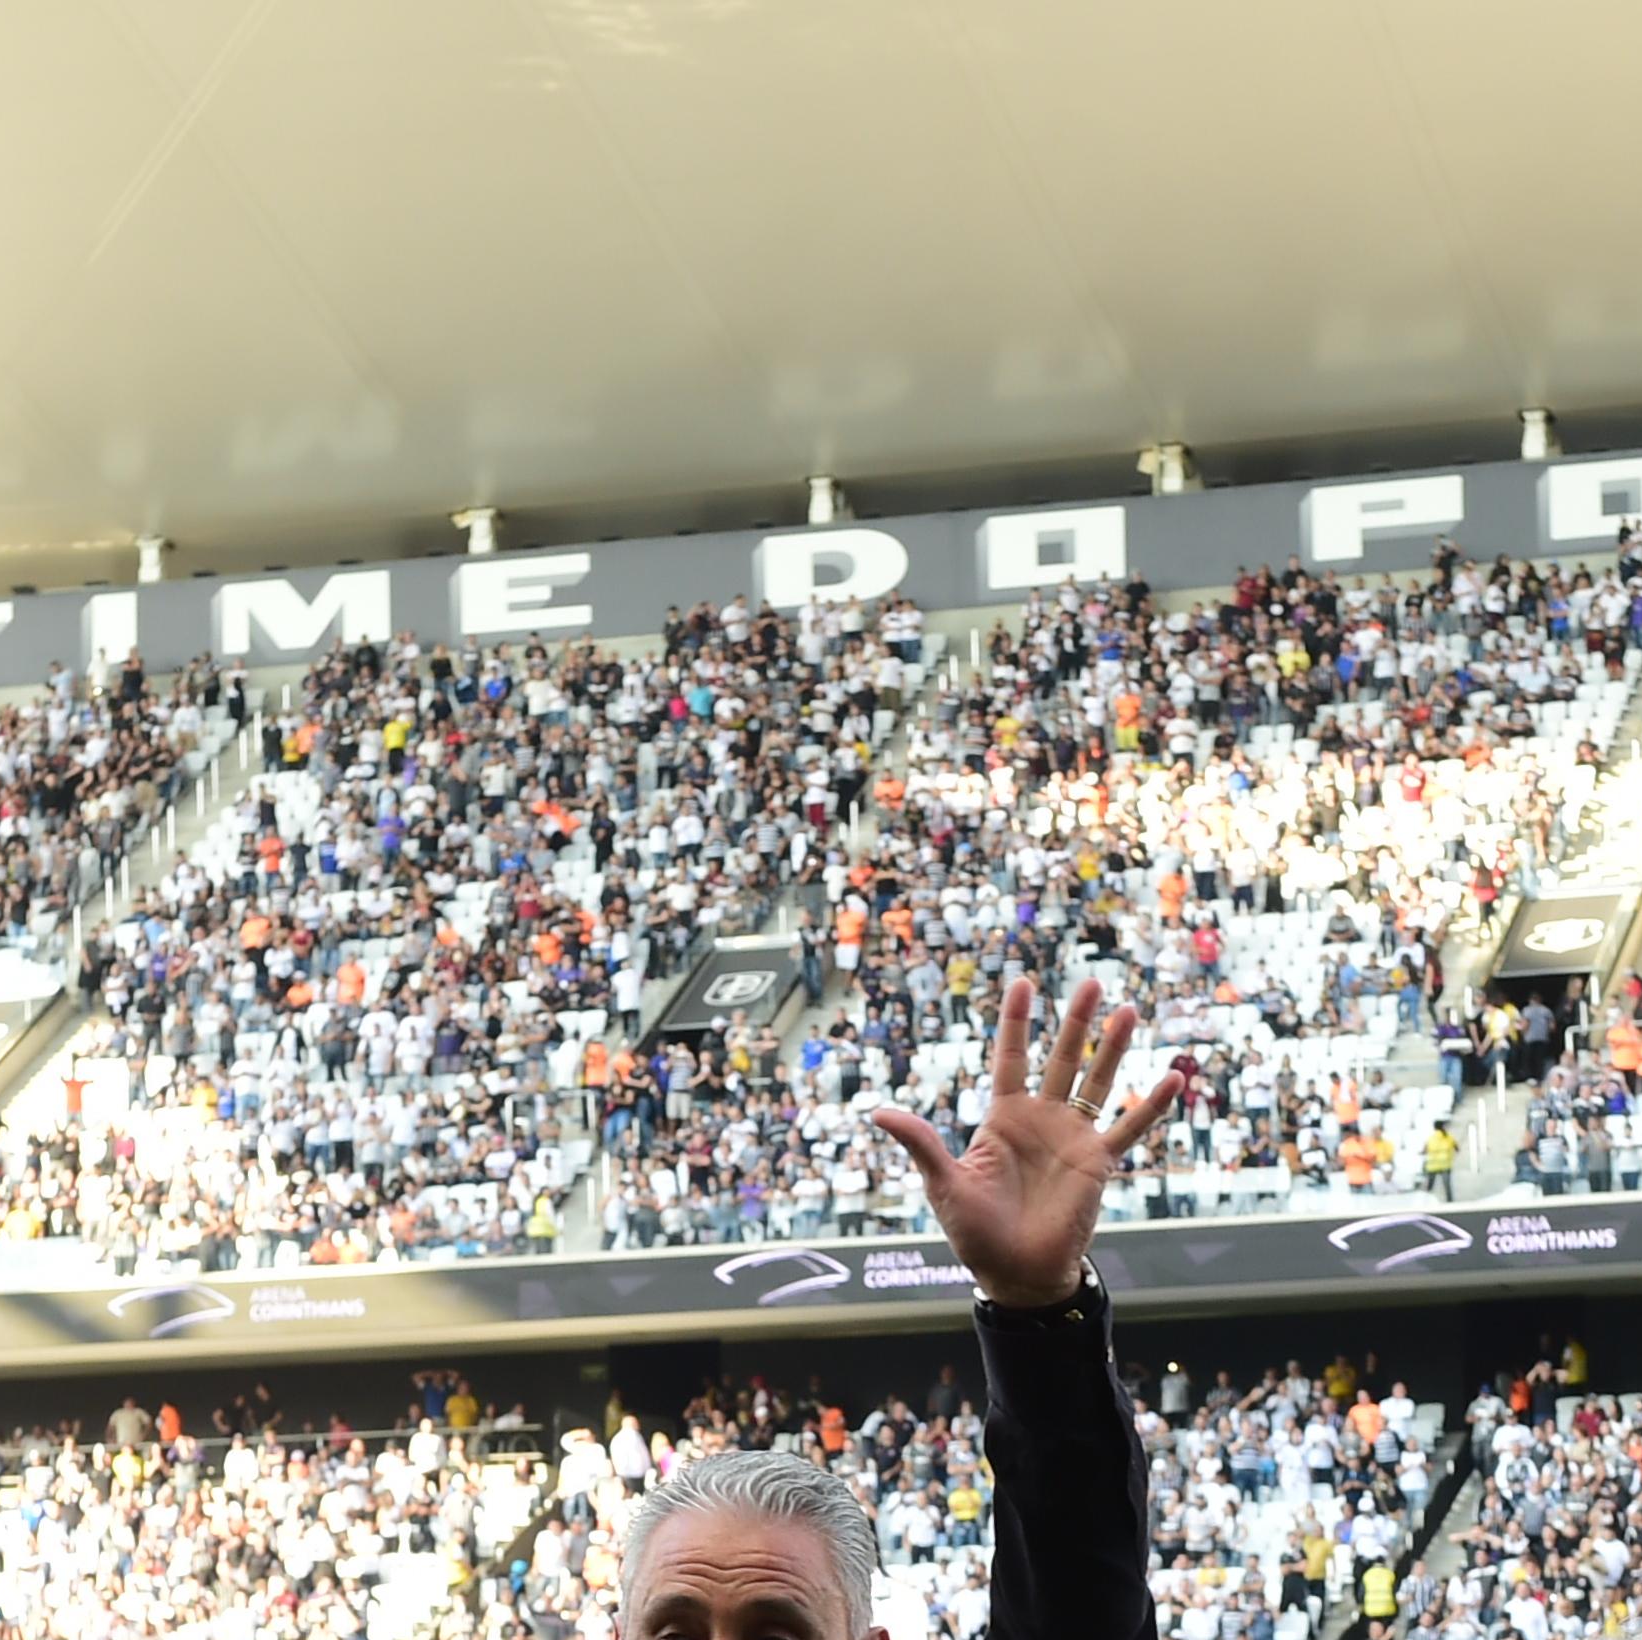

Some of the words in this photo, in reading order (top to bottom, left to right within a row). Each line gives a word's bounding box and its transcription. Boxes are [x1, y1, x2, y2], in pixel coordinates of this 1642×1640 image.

[753, 505, 1126, 608] DO
[1487, 1214, 1550, 1234] ARENA
[1487, 1227, 1617, 1254] CORINTHIANS
[863, 1251, 925, 1269] ARENA
[863, 1264, 976, 1289] CORINTHIAN
[249, 1297, 366, 1323] CORINTHIANS
